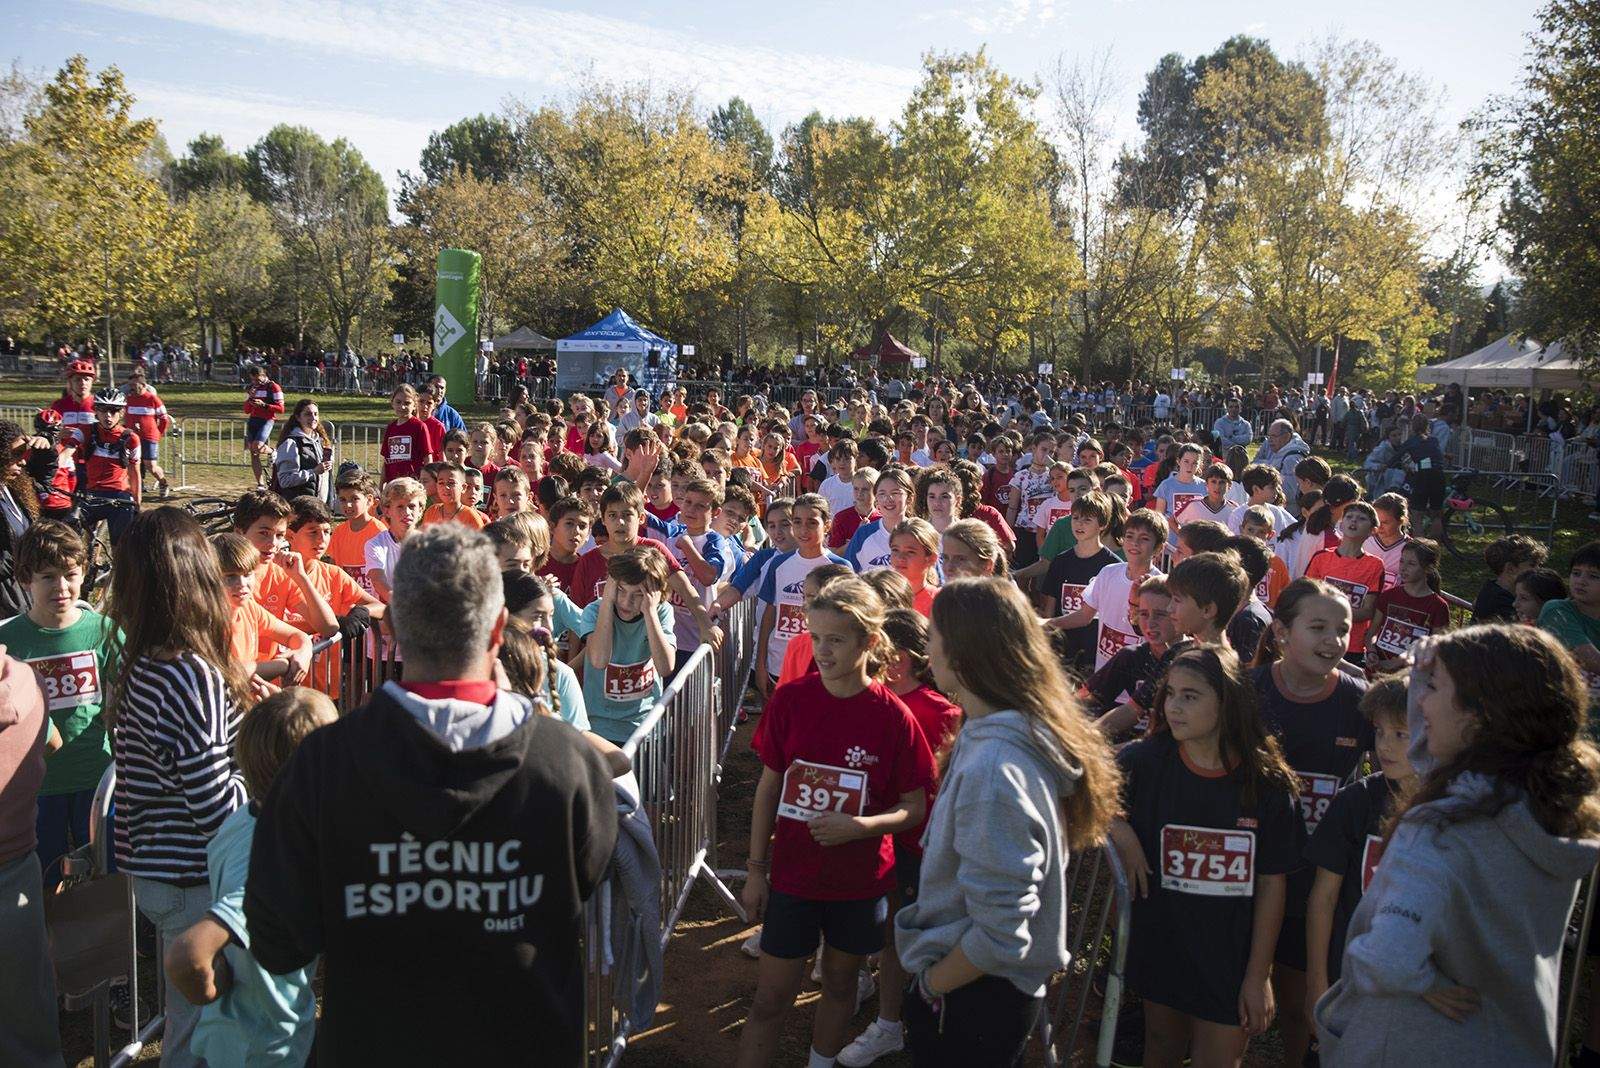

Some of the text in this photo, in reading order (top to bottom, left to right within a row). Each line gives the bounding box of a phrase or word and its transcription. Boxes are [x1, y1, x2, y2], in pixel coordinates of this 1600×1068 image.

[390, 444, 406, 454] 399
[795, 783, 849, 815] 397
[369, 831, 521, 877] TÈCNIC
[1167, 849, 1253, 880] 3754
[344, 873, 544, 920] ESPORTIU
[483, 914, 525, 932] OMET
